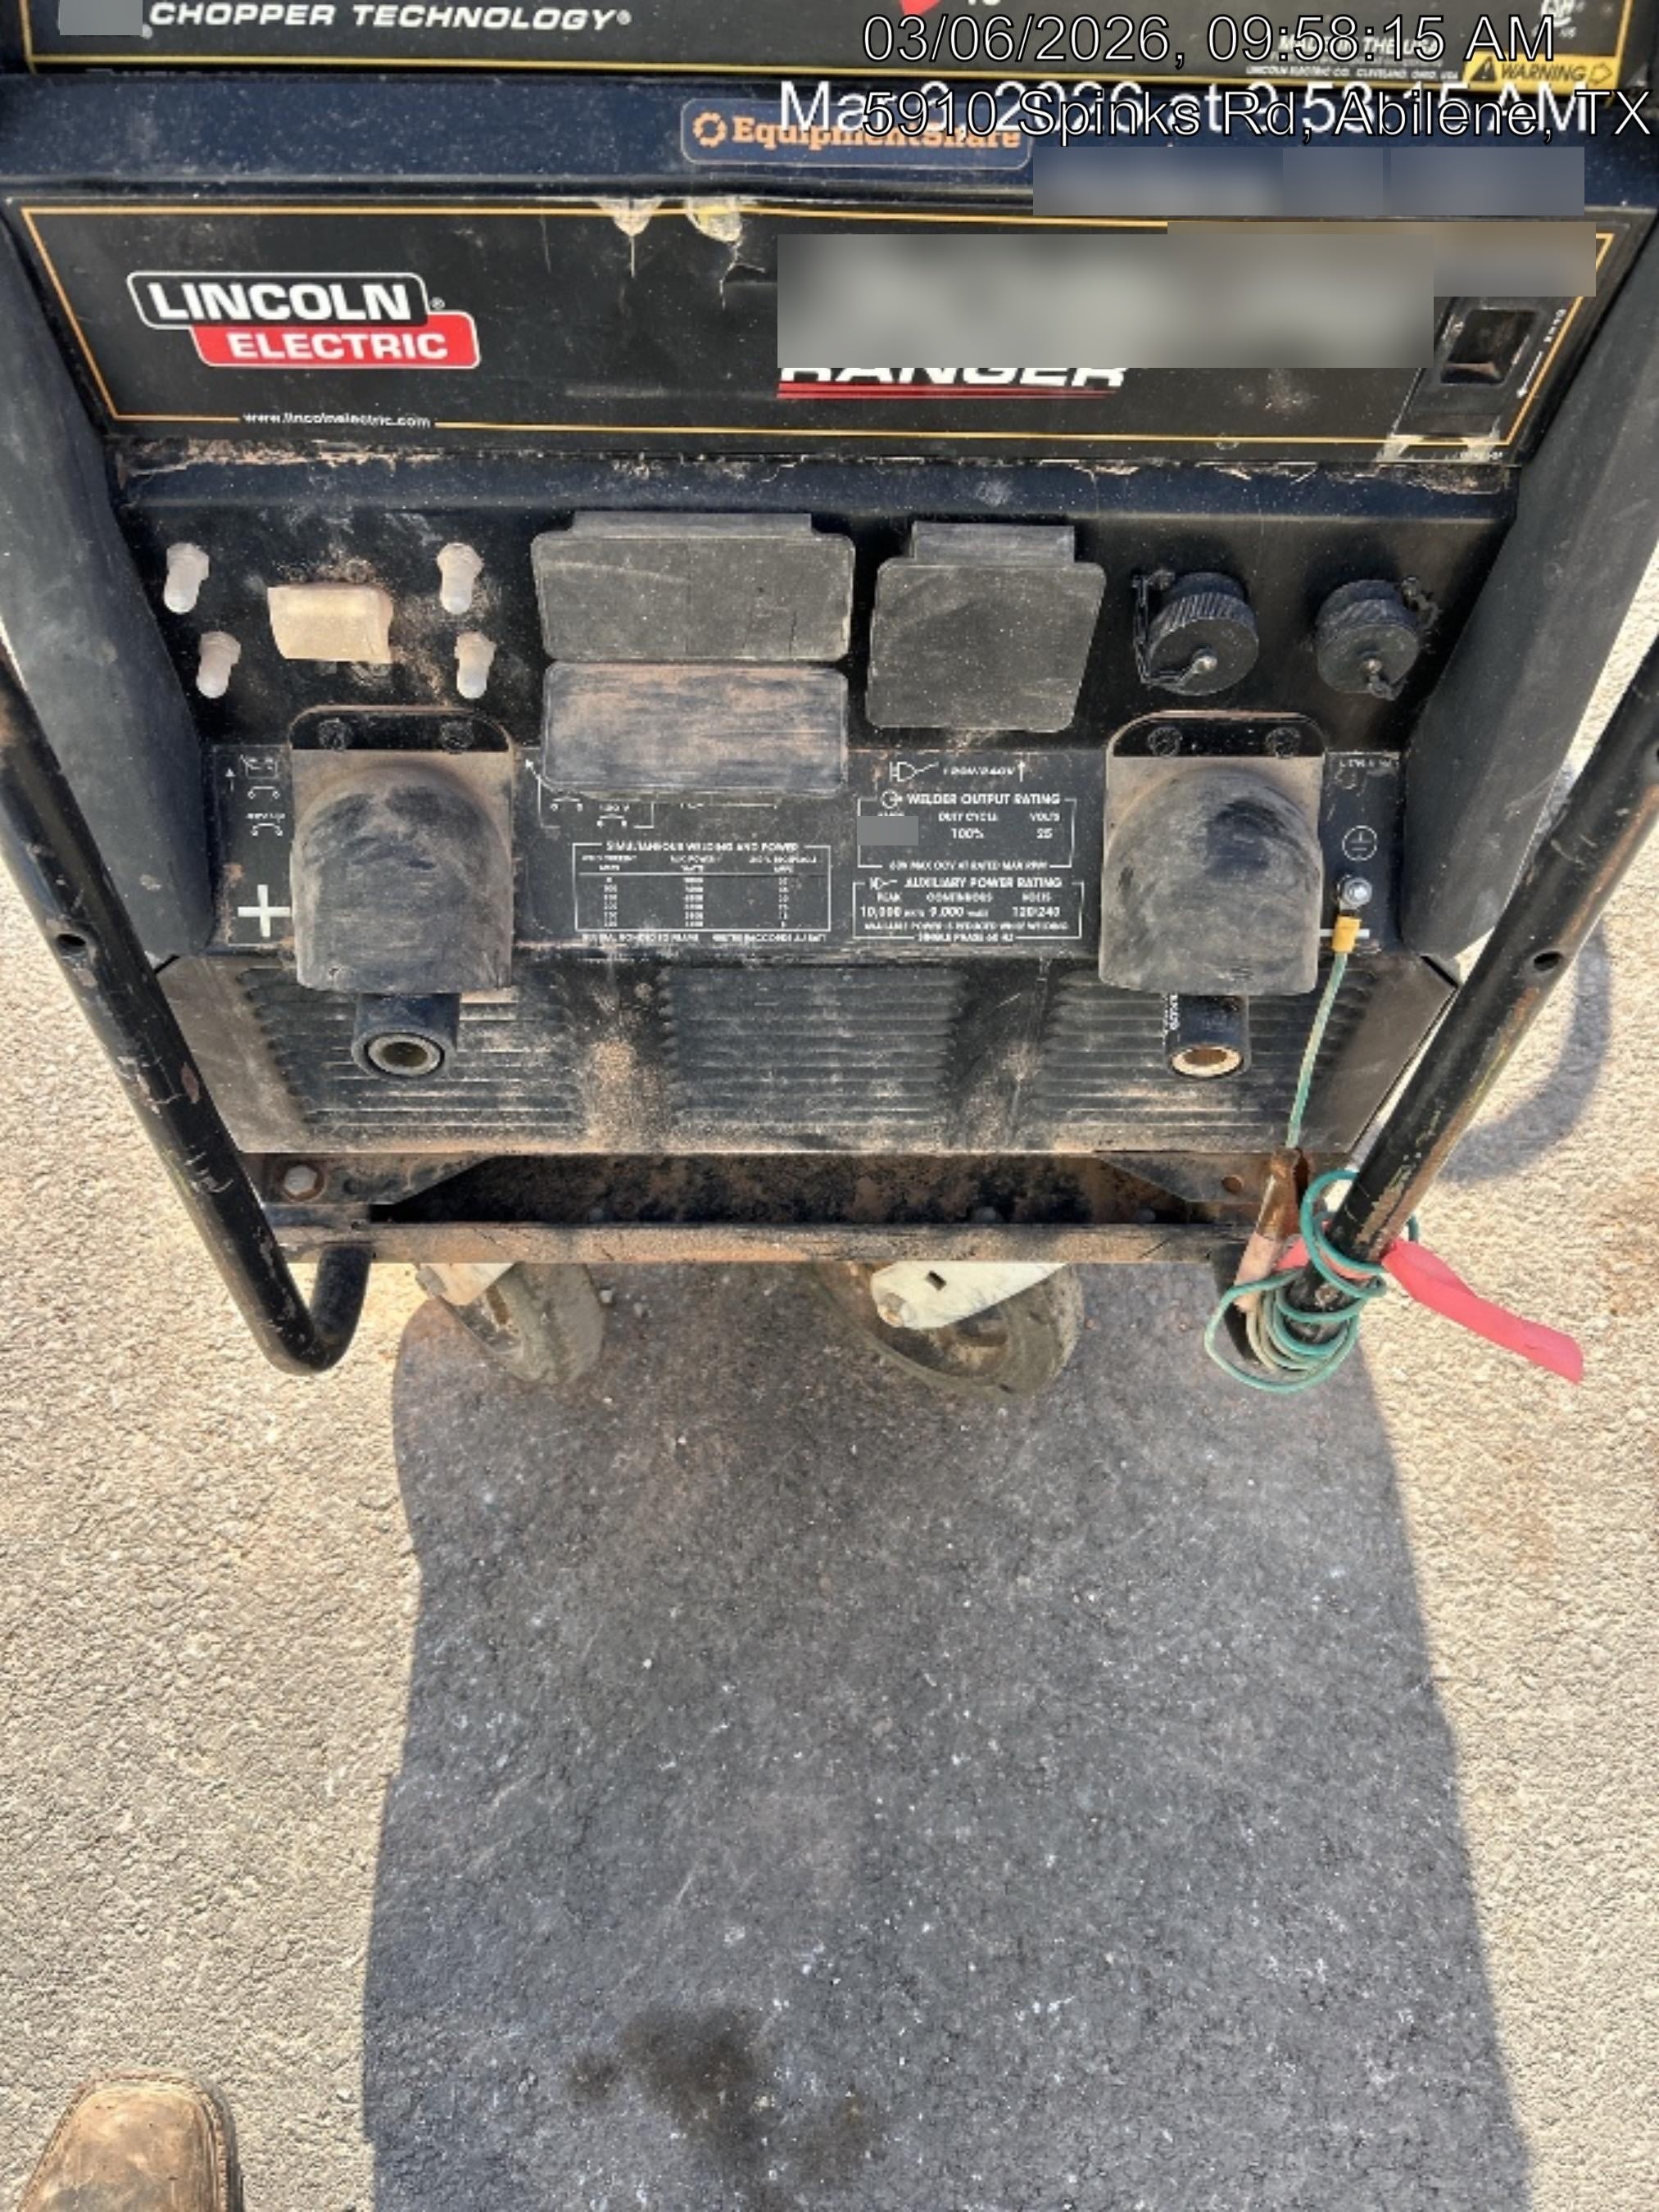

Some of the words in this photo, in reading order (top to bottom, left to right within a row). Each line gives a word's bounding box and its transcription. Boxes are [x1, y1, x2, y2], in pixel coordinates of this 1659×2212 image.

[150, 4, 337, 25] CHOPPER
[1501, 64, 1588, 80] WARNING
[226, 333, 448, 360] ELECTRIC
[906, 792, 958, 805] WELDER
[960, 792, 1011, 805] OUTPUT
[1013, 792, 1061, 805] RATING
[950, 827, 984, 839] 100%
[970, 877, 1014, 888] POWER
[1017, 877, 1063, 888] RATING
